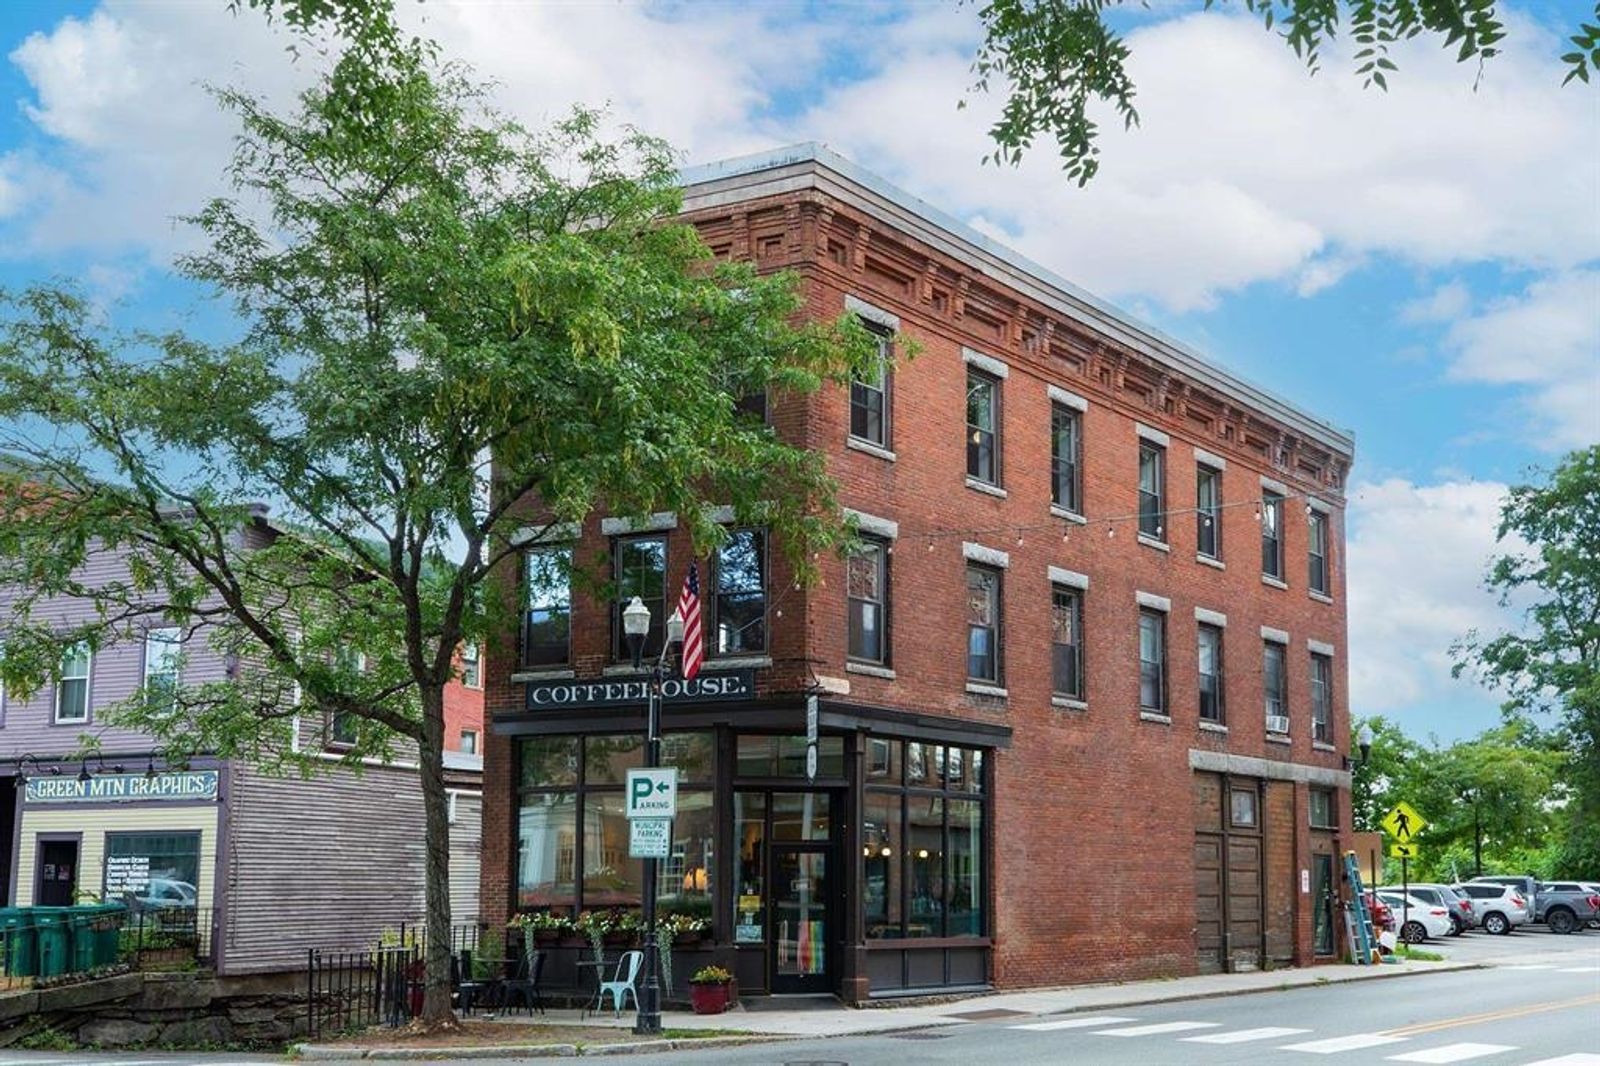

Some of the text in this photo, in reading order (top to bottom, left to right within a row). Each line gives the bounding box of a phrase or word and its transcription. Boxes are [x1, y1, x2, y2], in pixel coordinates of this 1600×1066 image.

[37, 775, 205, 798] GREEN MTN GRAPHICS
